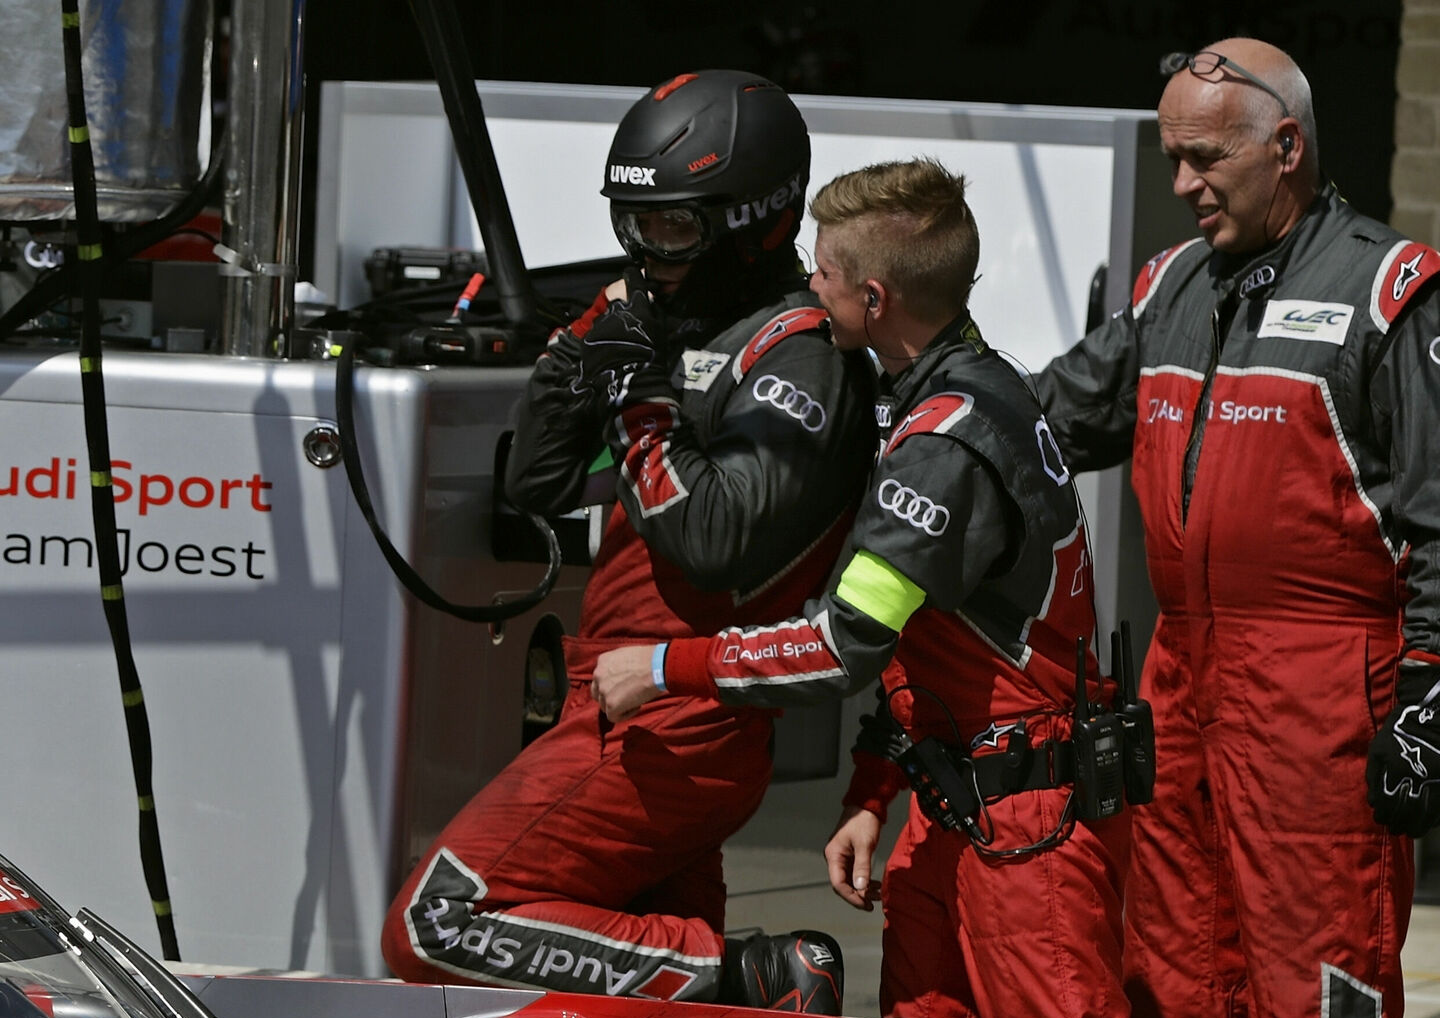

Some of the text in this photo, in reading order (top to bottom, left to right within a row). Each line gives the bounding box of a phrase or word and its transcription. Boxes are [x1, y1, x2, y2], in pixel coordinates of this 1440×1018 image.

[610, 164, 657, 187] uvex
[688, 152, 719, 173] uvex
[726, 173, 802, 230] uvex
[1219, 400, 1288, 425] Sport
[109, 459, 273, 517] Sport
[117, 528, 267, 581] Joest
[740, 644, 779, 661] Audi
[526, 938, 638, 996] Audi
